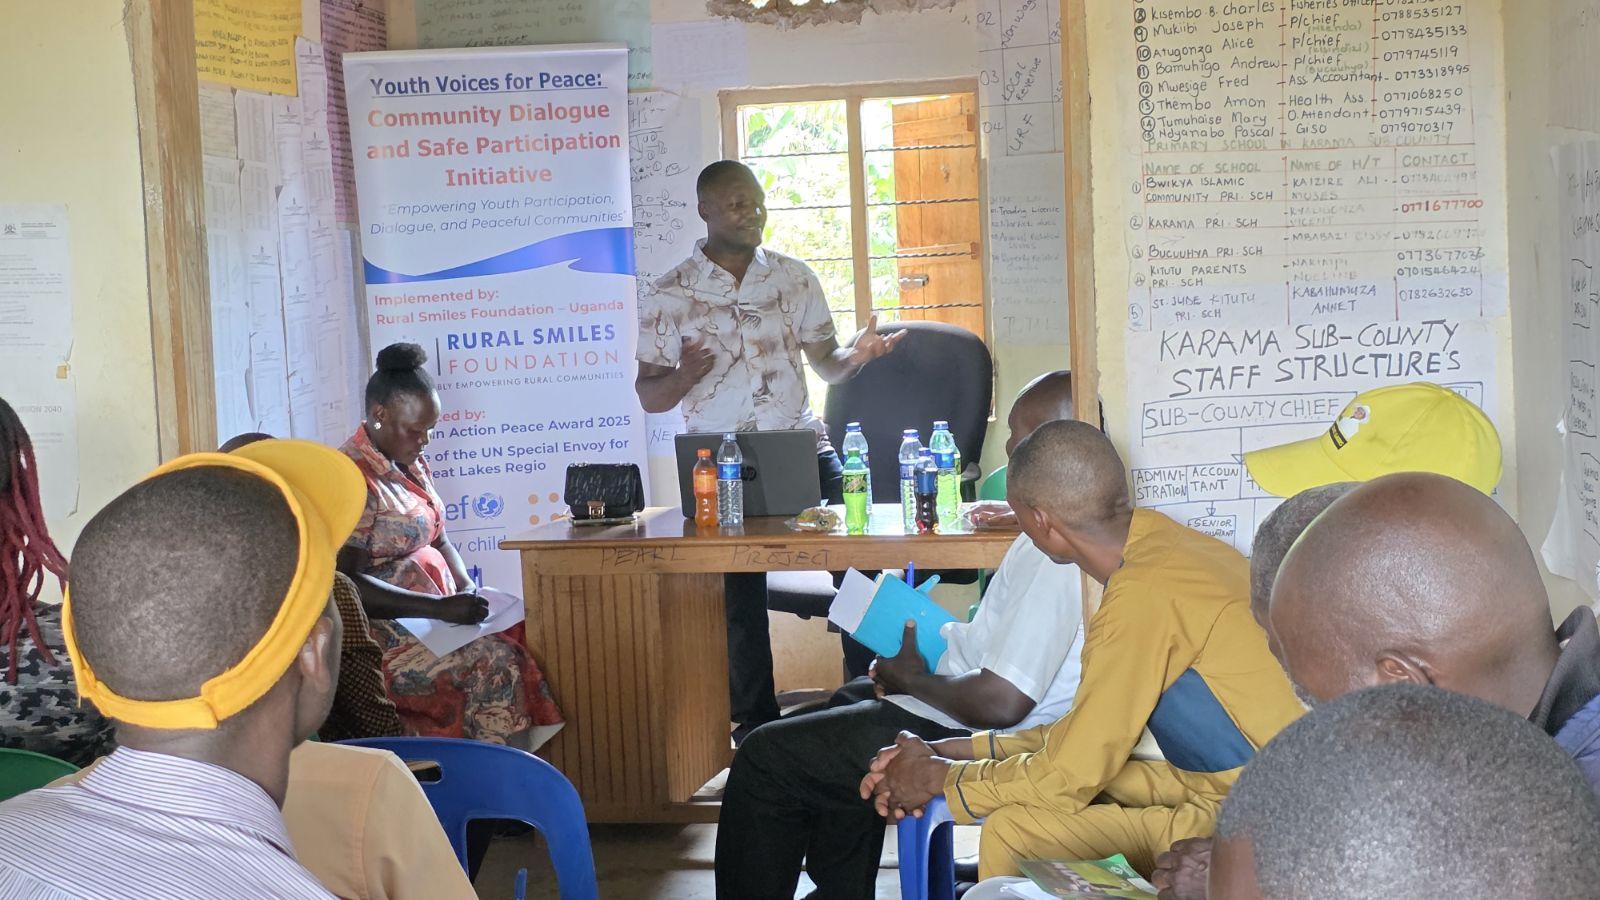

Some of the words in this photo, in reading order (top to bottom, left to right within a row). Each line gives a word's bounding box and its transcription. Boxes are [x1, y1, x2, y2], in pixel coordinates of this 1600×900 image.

[976, 11, 996, 26] 02
[1212, 18, 1264, 34] Joseph
[1138, 46, 1150, 60] 10
[1222, 37, 1255, 50] Alice
[1381, 24, 1468, 41] 0778435133
[1230, 56, 1280, 69] Andrew
[370, 76, 430, 95] Youth
[436, 74, 500, 92] Voices
[504, 72, 534, 90] for
[539, 71, 602, 88] Peace:
[980, 70, 1000, 86] 03
[1141, 83, 1151, 95] 12
[1158, 80, 1207, 98] Mwesige
[1218, 75, 1249, 88] Fred
[1313, 72, 1384, 82] Accountant
[1157, 98, 1212, 111] Thembo
[1224, 96, 1266, 108] Amon
[1289, 94, 1333, 106] Health
[1344, 92, 1364, 104] Ass
[1384, 88, 1463, 103] 0771068250
[368, 105, 502, 128] Community
[509, 102, 610, 124] Dialogue
[1232, 112, 1267, 127] Mary
[1380, 122, 1454, 134] 0779070317
[366, 140, 410, 160] and
[417, 136, 469, 157] Safe
[476, 131, 620, 154] Participation
[1148, 138, 1208, 152] PRIMARY
[1224, 138, 1268, 150] SCHOOL
[1190, 163, 1205, 174] OF
[1214, 162, 1261, 174] SCHOOL
[1290, 159, 1321, 172] NAME
[1328, 160, 1342, 171] OF
[1352, 154, 1381, 170] H/T
[1402, 152, 1468, 168] CONTACT
[445, 165, 552, 186] Initiative
[1200, 176, 1246, 186] ISLAMIC
[480, 194, 520, 210] Youth
[524, 193, 614, 211] Participation,
[1146, 192, 1209, 202] COMMUNITY
[1250, 190, 1274, 200] SCH
[370, 218, 437, 236] Dialogue,
[440, 217, 467, 231] and
[472, 214, 530, 230] Peaceful
[1148, 216, 1194, 230] KARAMA
[1236, 218, 1258, 228] SCH
[1242, 246, 1264, 256] SCH
[1150, 266, 1182, 276] KITUTU
[1192, 264, 1248, 275] PARENTS
[1181, 278, 1204, 286] SCH
[374, 290, 474, 306] Implemented
[478, 288, 500, 302] by:
[376, 312, 414, 325] Rural
[418, 310, 467, 324] Smiles
[471, 304, 554, 319] Foundation
[570, 300, 624, 316] Uganda
[447, 330, 524, 351] RURAL
[533, 324, 616, 345] SMILES
[1160, 328, 1282, 361] KARAMA
[1294, 320, 1459, 352] SUB-COUNTY
[450, 350, 619, 375] FOUNDATION
[456, 376, 522, 390] EMPOWERING
[524, 375, 554, 386] RURAL
[556, 372, 624, 384] COMMUNITIES
[1170, 364, 1262, 398] STAFF
[464, 410, 486, 424] by:
[450, 424, 496, 438] Action
[501, 420, 544, 434] Peace
[548, 418, 594, 431] Award
[598, 416, 631, 428] 2025
[434, 450, 450, 462] of
[453, 448, 478, 460] the
[482, 446, 503, 458] UN
[507, 440, 559, 458] Special
[563, 440, 606, 454] Envoy
[609, 438, 630, 450] for
[459, 462, 501, 478] Lakes
[1192, 467, 1239, 478] ACCOUN
[1136, 484, 1188, 500] STRATION
[1190, 479, 1228, 492] TANT
[1194, 519, 1232, 528] SENIOR
